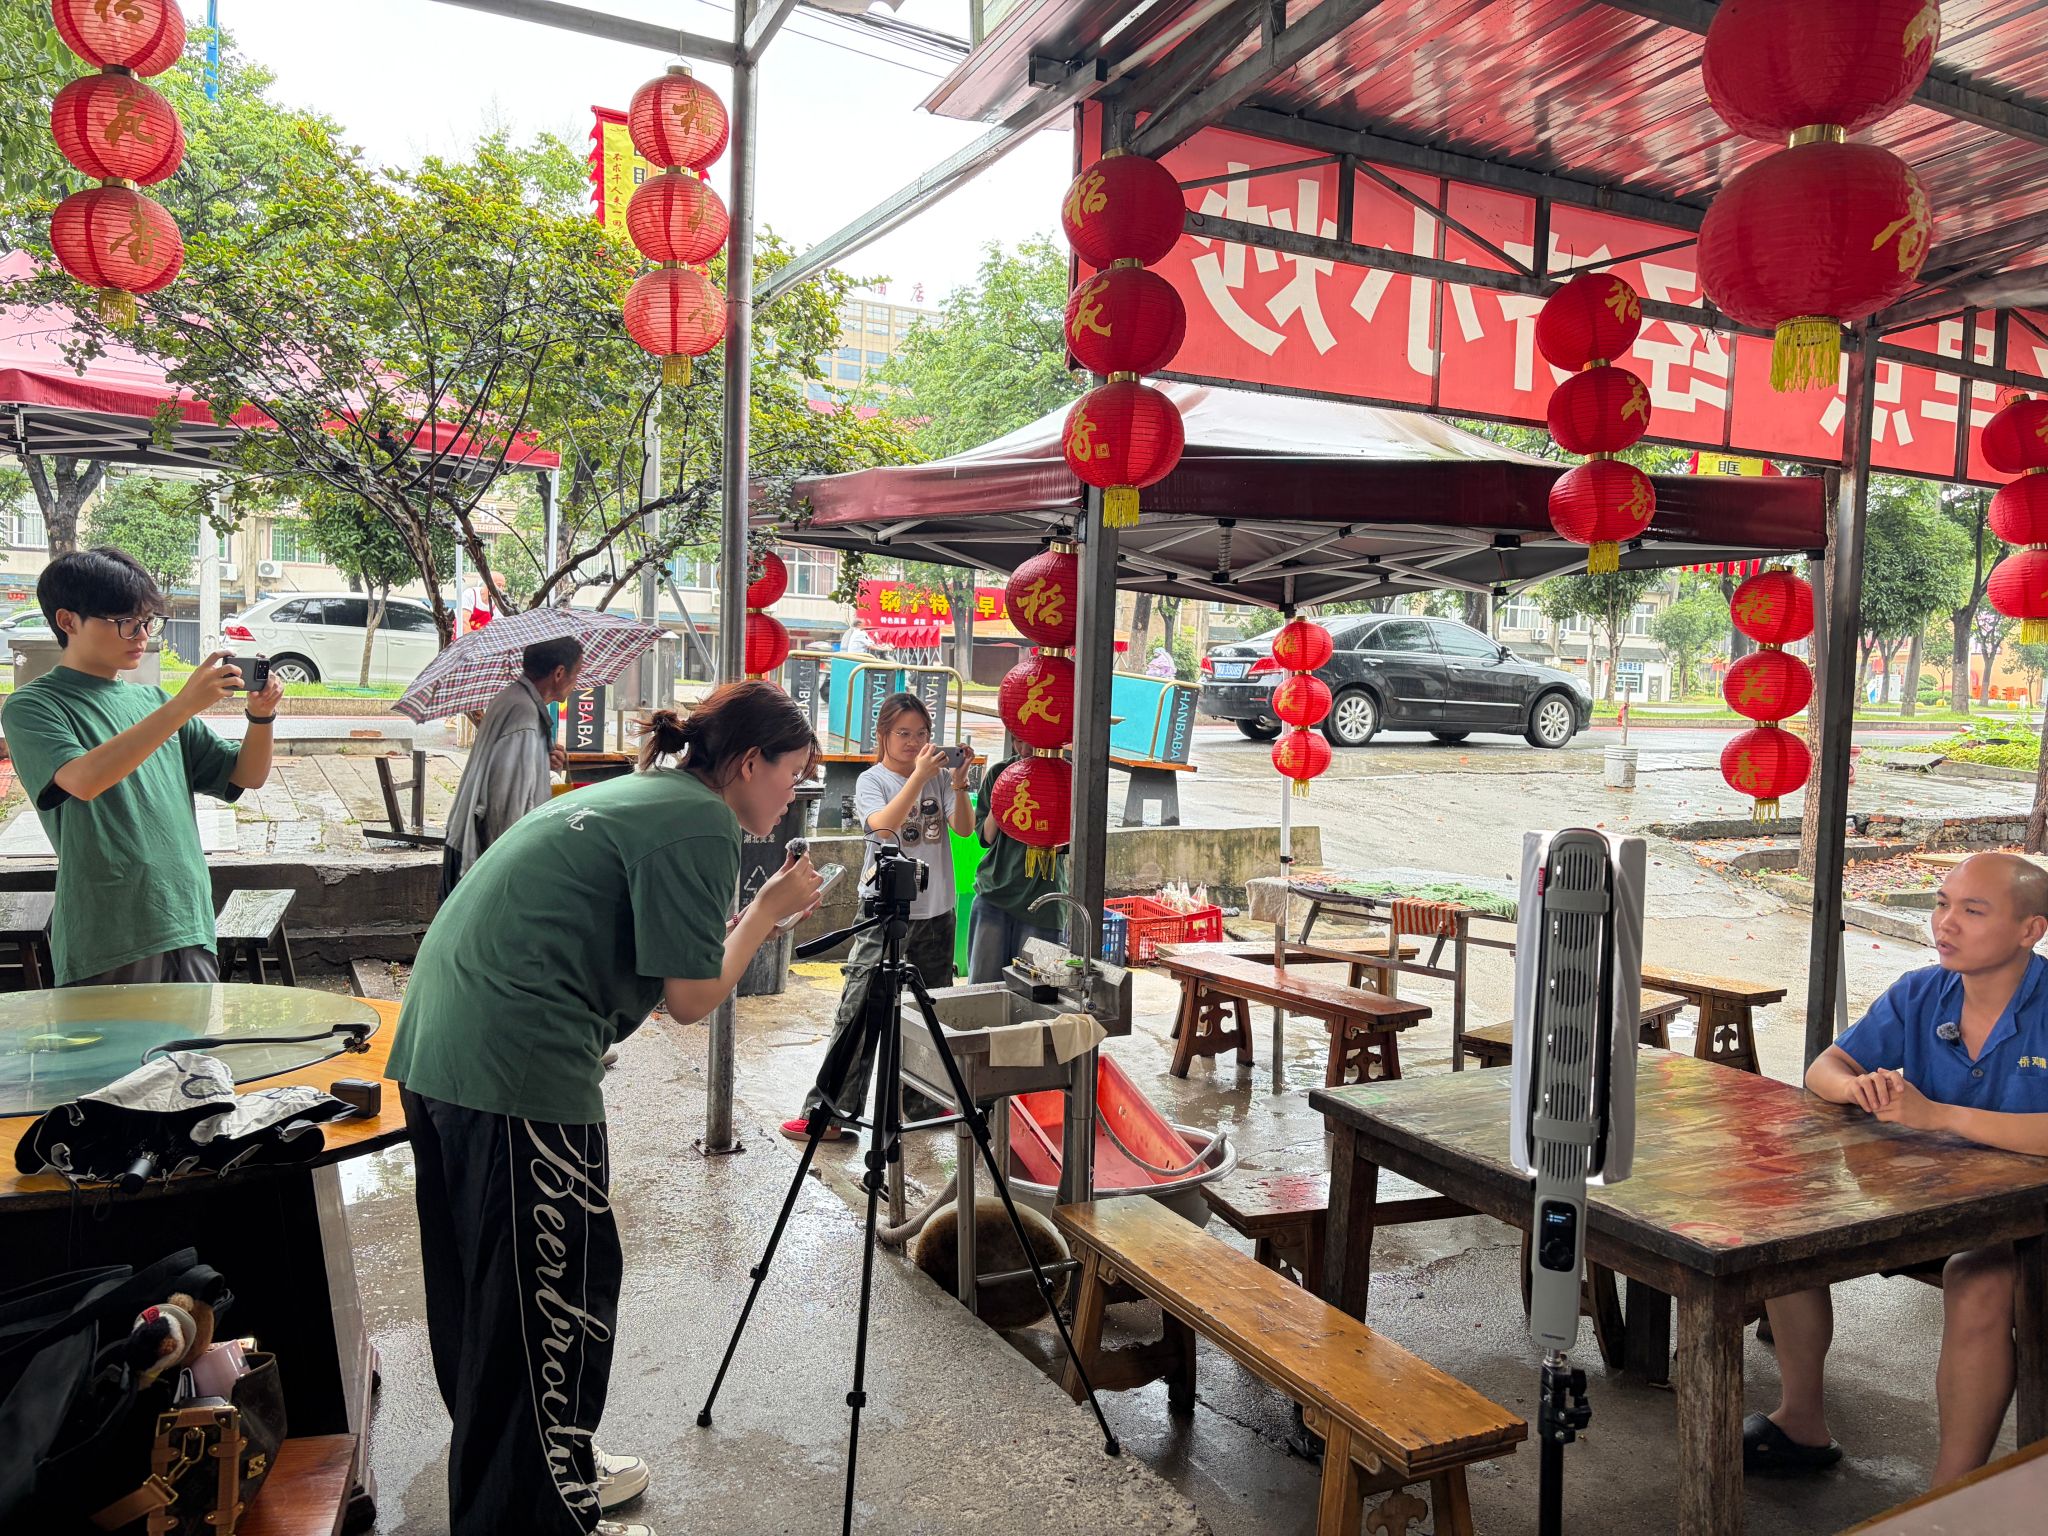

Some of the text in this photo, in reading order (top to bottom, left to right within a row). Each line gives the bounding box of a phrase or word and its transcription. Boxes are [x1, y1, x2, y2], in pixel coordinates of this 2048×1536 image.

[1064, 170, 1107, 228] 稻
[1071, 279, 1112, 342] 花
[1736, 589, 1774, 625] 稻
[1002, 577, 1066, 831] 稻 花 香
[1738, 666, 1774, 706] 花
[1170, 690, 1191, 760] HANBABA
